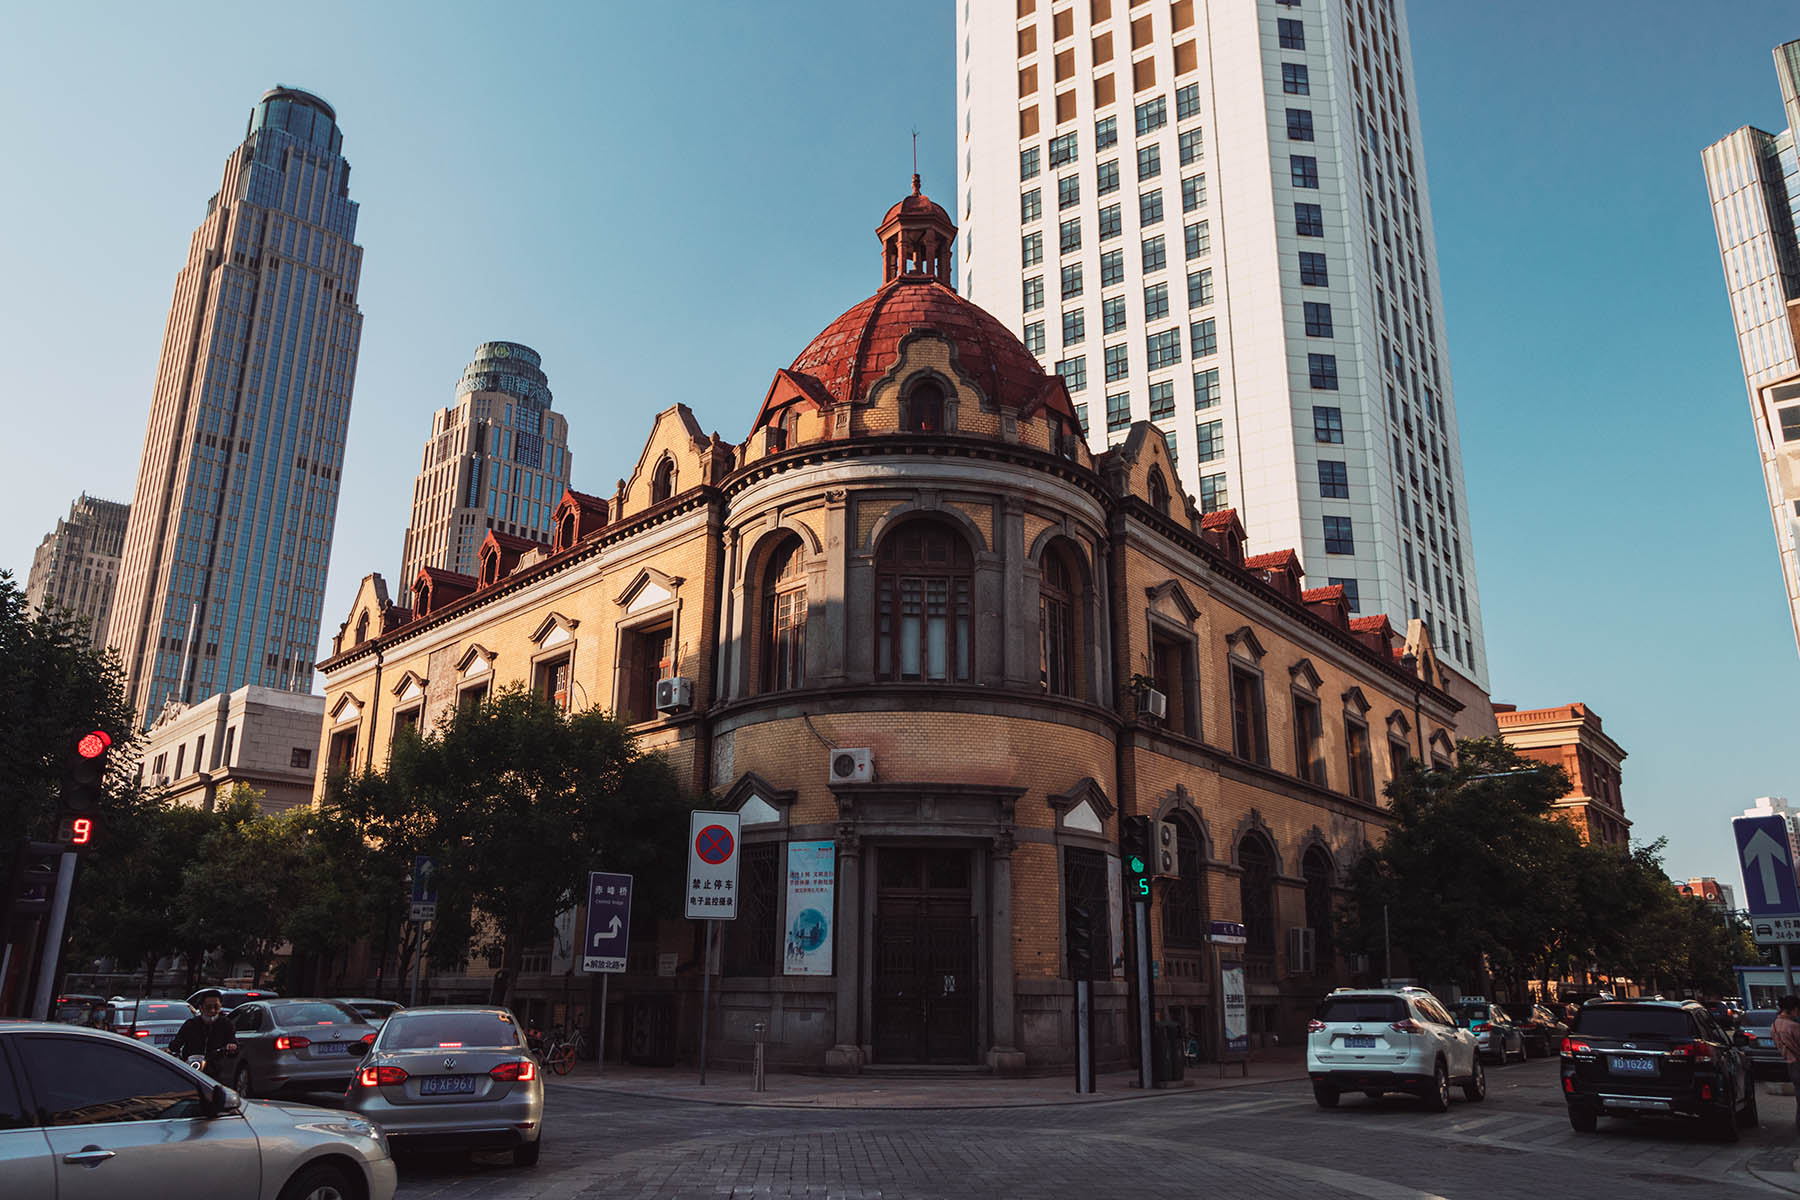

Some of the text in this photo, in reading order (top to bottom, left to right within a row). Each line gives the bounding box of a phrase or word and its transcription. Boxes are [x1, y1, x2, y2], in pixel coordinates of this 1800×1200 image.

[73, 818, 92, 843] 9
[692, 878, 733, 890] 禁止停车
[1138, 877, 1150, 896] 5
[590, 959, 620, 969] 解放北路
